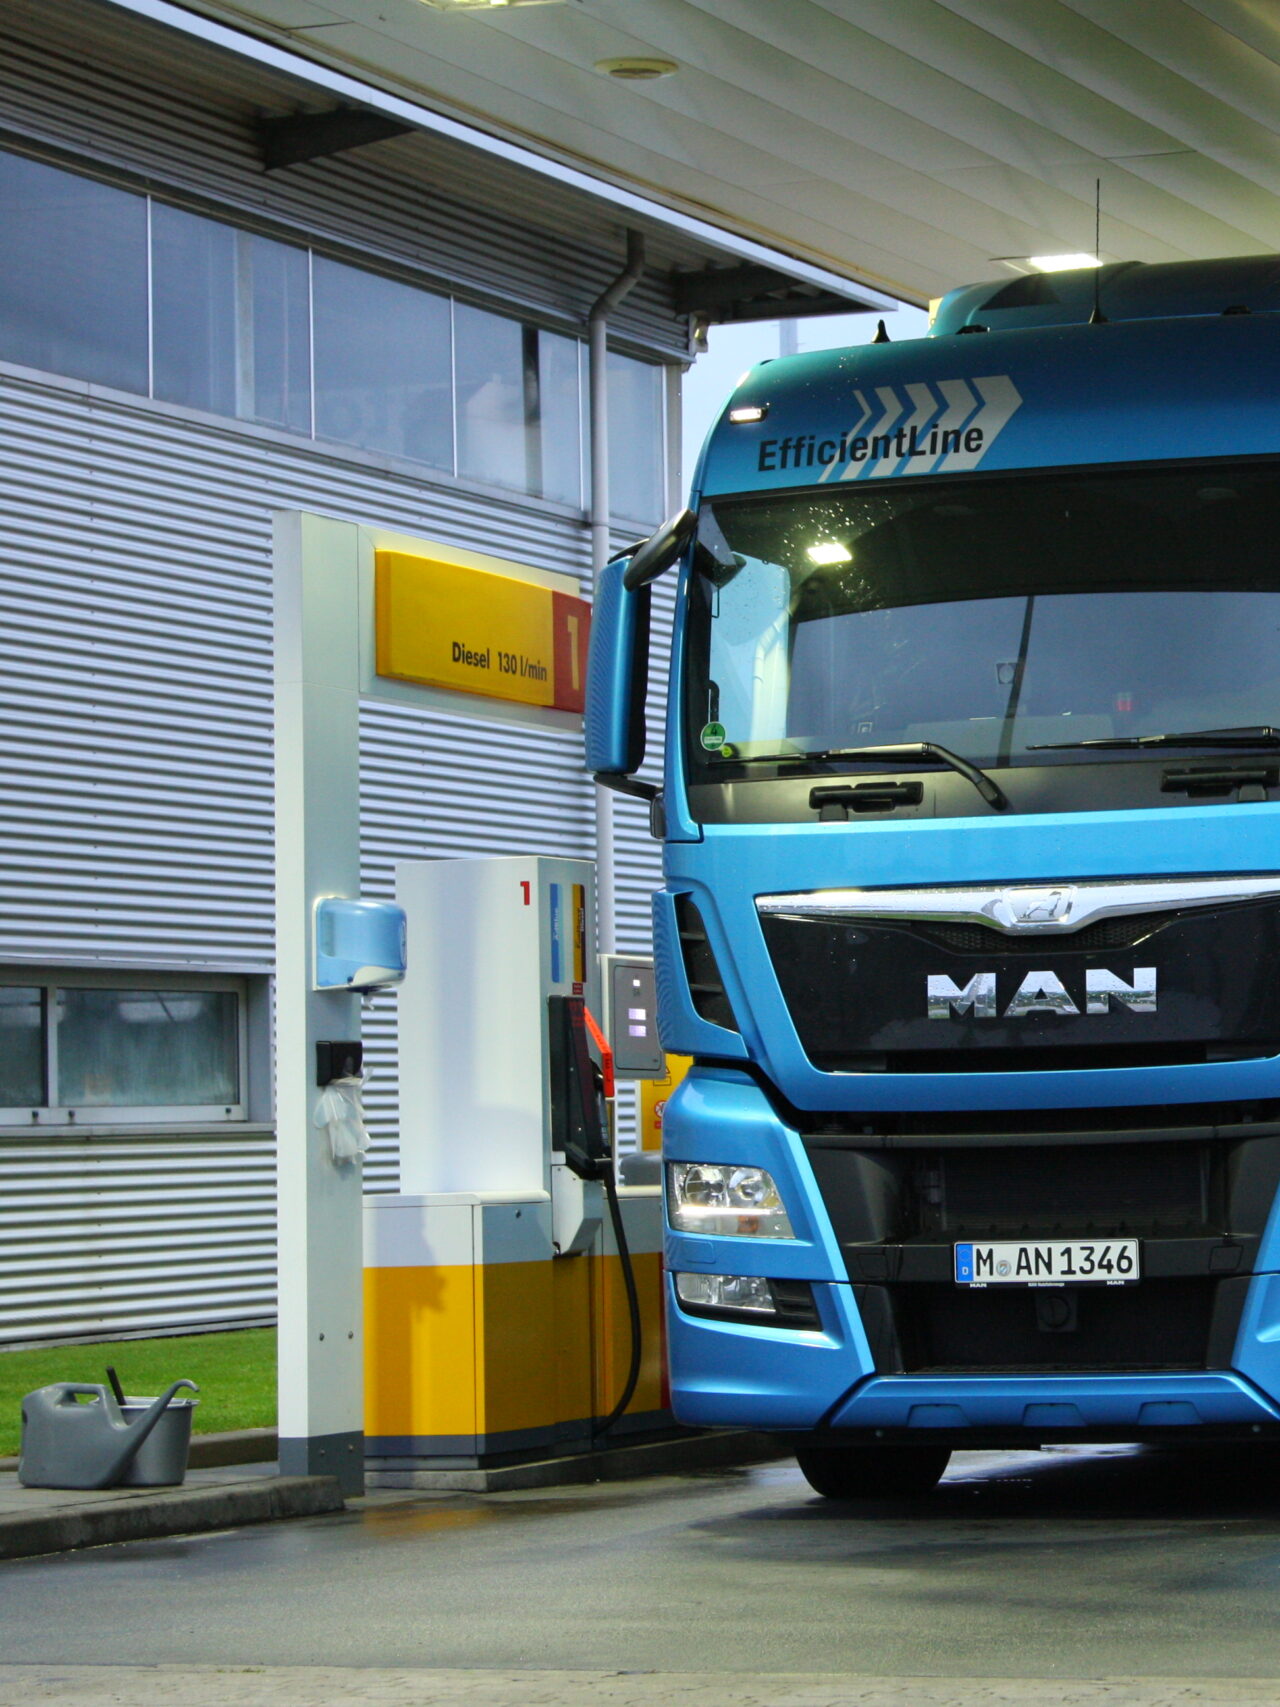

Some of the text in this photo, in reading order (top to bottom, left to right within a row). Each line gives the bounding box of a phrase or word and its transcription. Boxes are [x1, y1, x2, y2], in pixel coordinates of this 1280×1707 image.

[758, 423, 984, 472] EfficientLine
[452, 641, 548, 682] Diesel 130 l/min
[567, 615, 580, 691] 1
[520, 881, 531, 906] 1
[927, 966, 1157, 1019] MAN
[961, 1245, 1133, 1277] D M AN 1346
